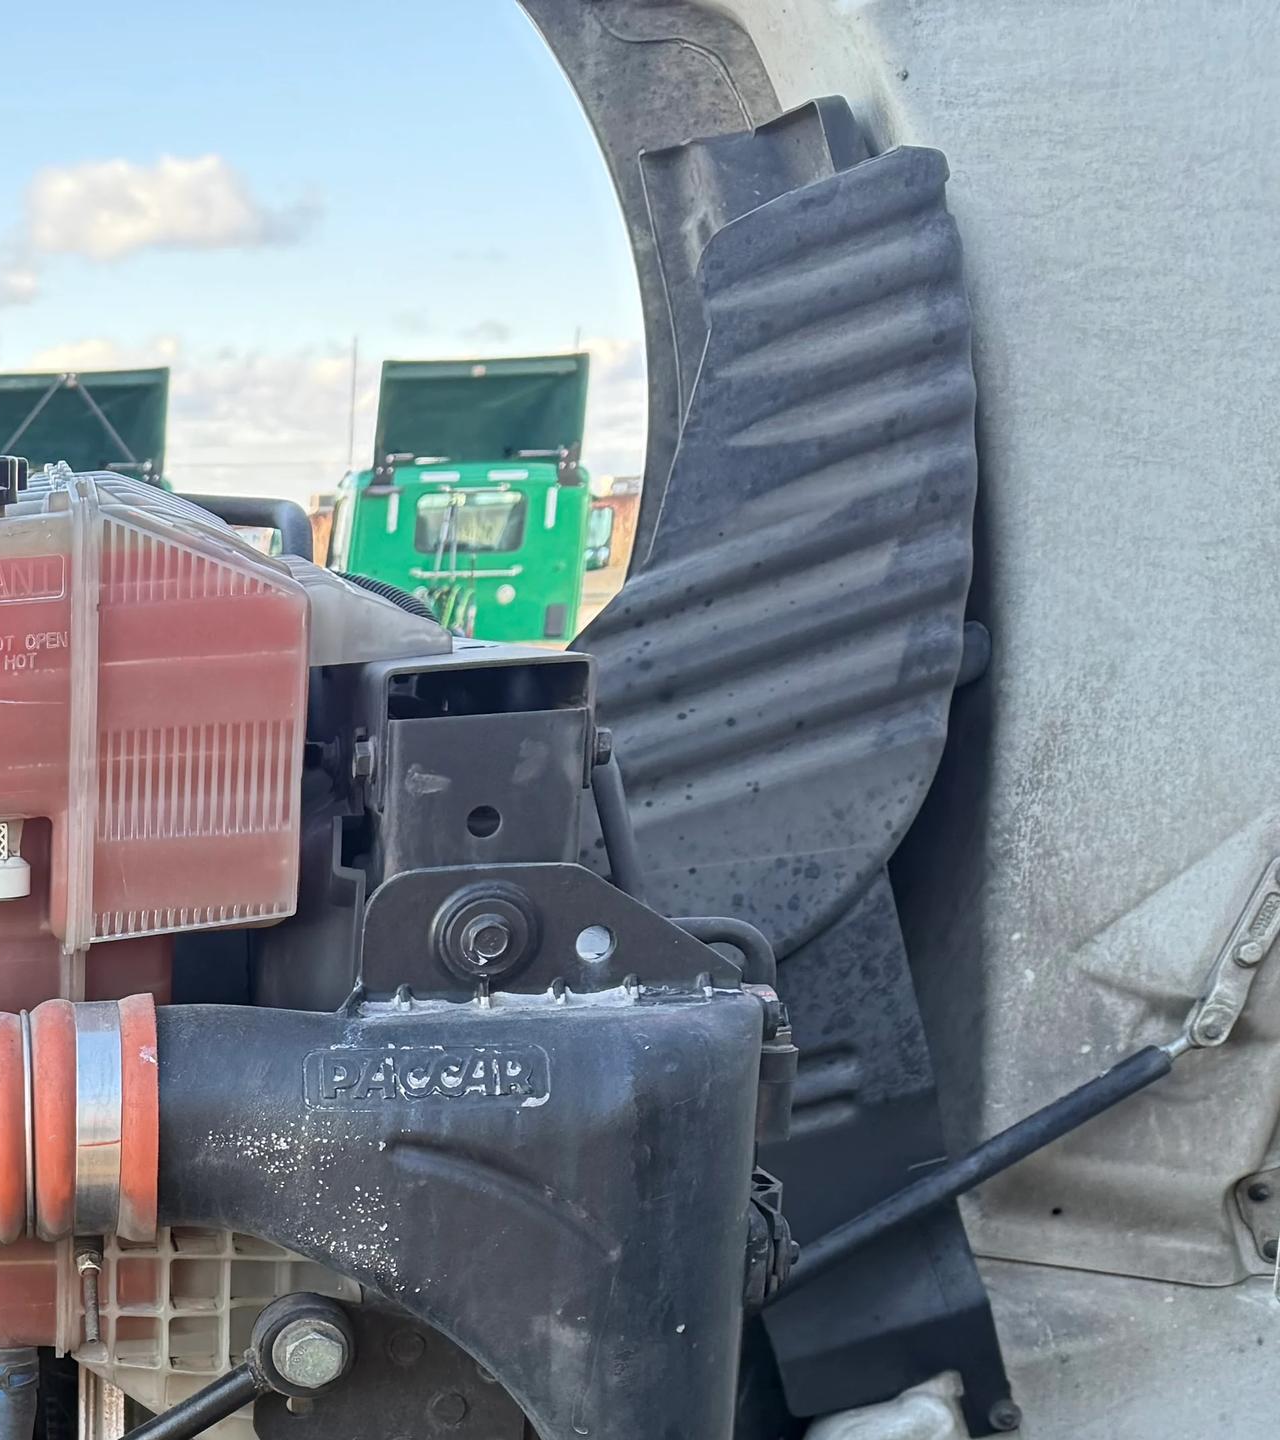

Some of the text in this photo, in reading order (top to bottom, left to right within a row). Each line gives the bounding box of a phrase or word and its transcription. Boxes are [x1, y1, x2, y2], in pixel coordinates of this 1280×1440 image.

[25, 631, 68, 650] OPEN
[4, 652, 37, 671] HOT
[321, 1055, 533, 1099] PACCAR
